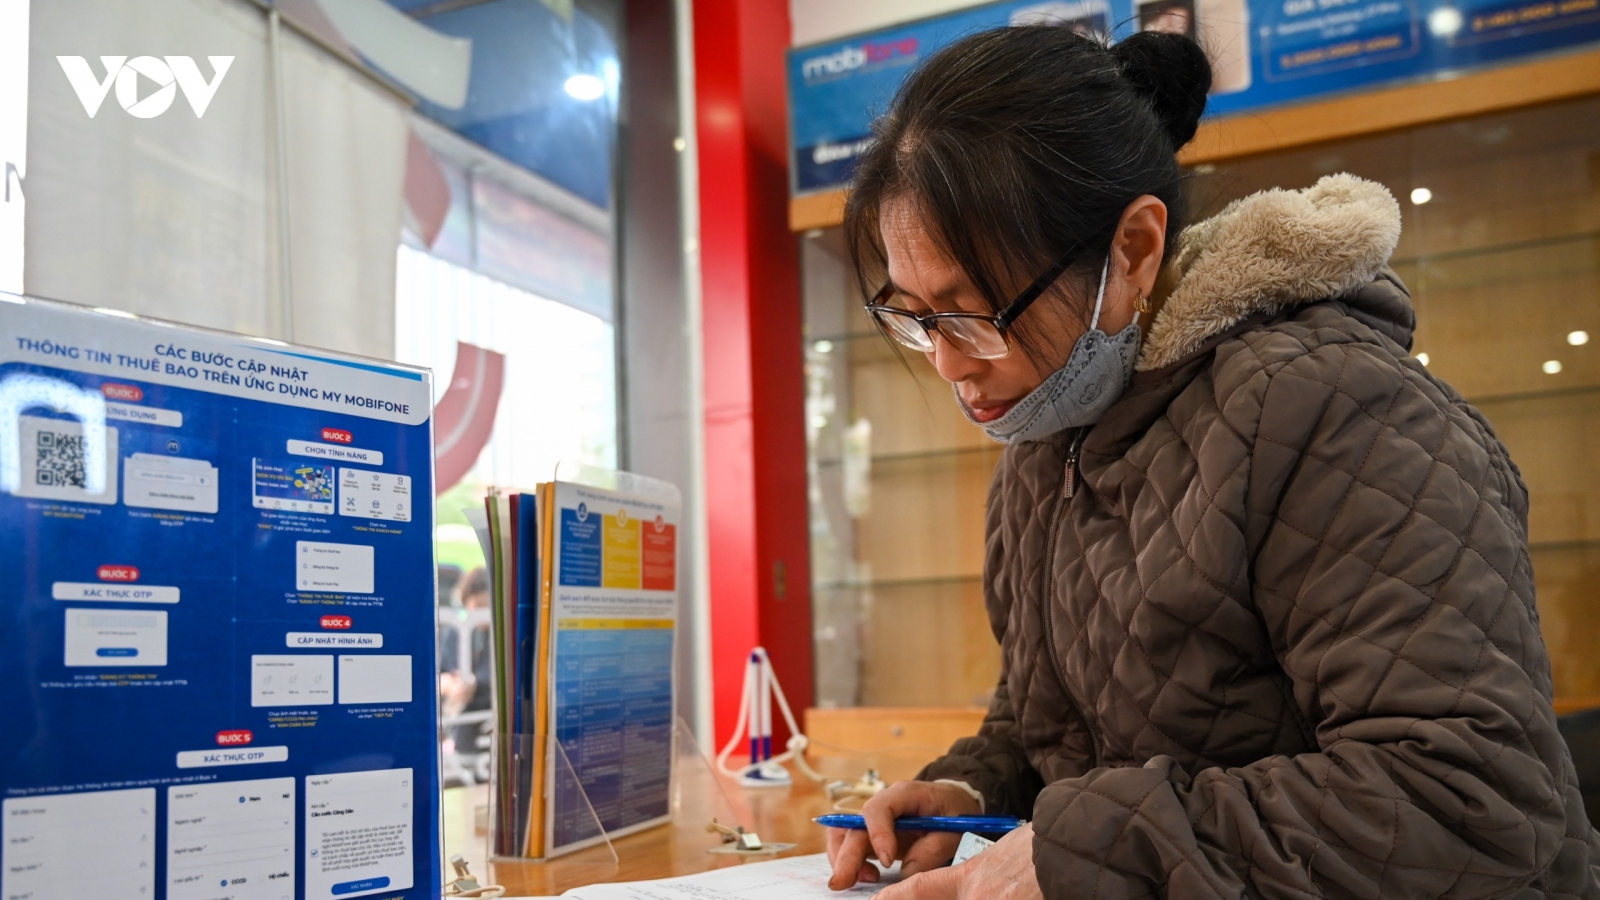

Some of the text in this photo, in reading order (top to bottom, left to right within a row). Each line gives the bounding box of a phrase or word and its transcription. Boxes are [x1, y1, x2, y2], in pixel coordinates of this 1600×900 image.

[154, 343, 309, 383] CÁC BƯỚC CẬP NHẬT
[16, 337, 410, 415] THÔNG TIN THUÊ BAO TRÊN ỨNG DỤNG MY MOBIFONE
[323, 431, 345, 442] BƯỚC
[305, 446, 368, 461] CHỌN TÍNH NĂNG
[99, 567, 137, 579] BƯỚC 3
[83, 587, 153, 599] XÁC THỰC OTP
[322, 618, 351, 627] BƯỚC 4
[297, 635, 373, 645] CẬP NHẬT HÌNH ẢNH
[218, 733, 251, 743] BƯỚC 5
[203, 752, 265, 763] XÁC THỰC OTP
